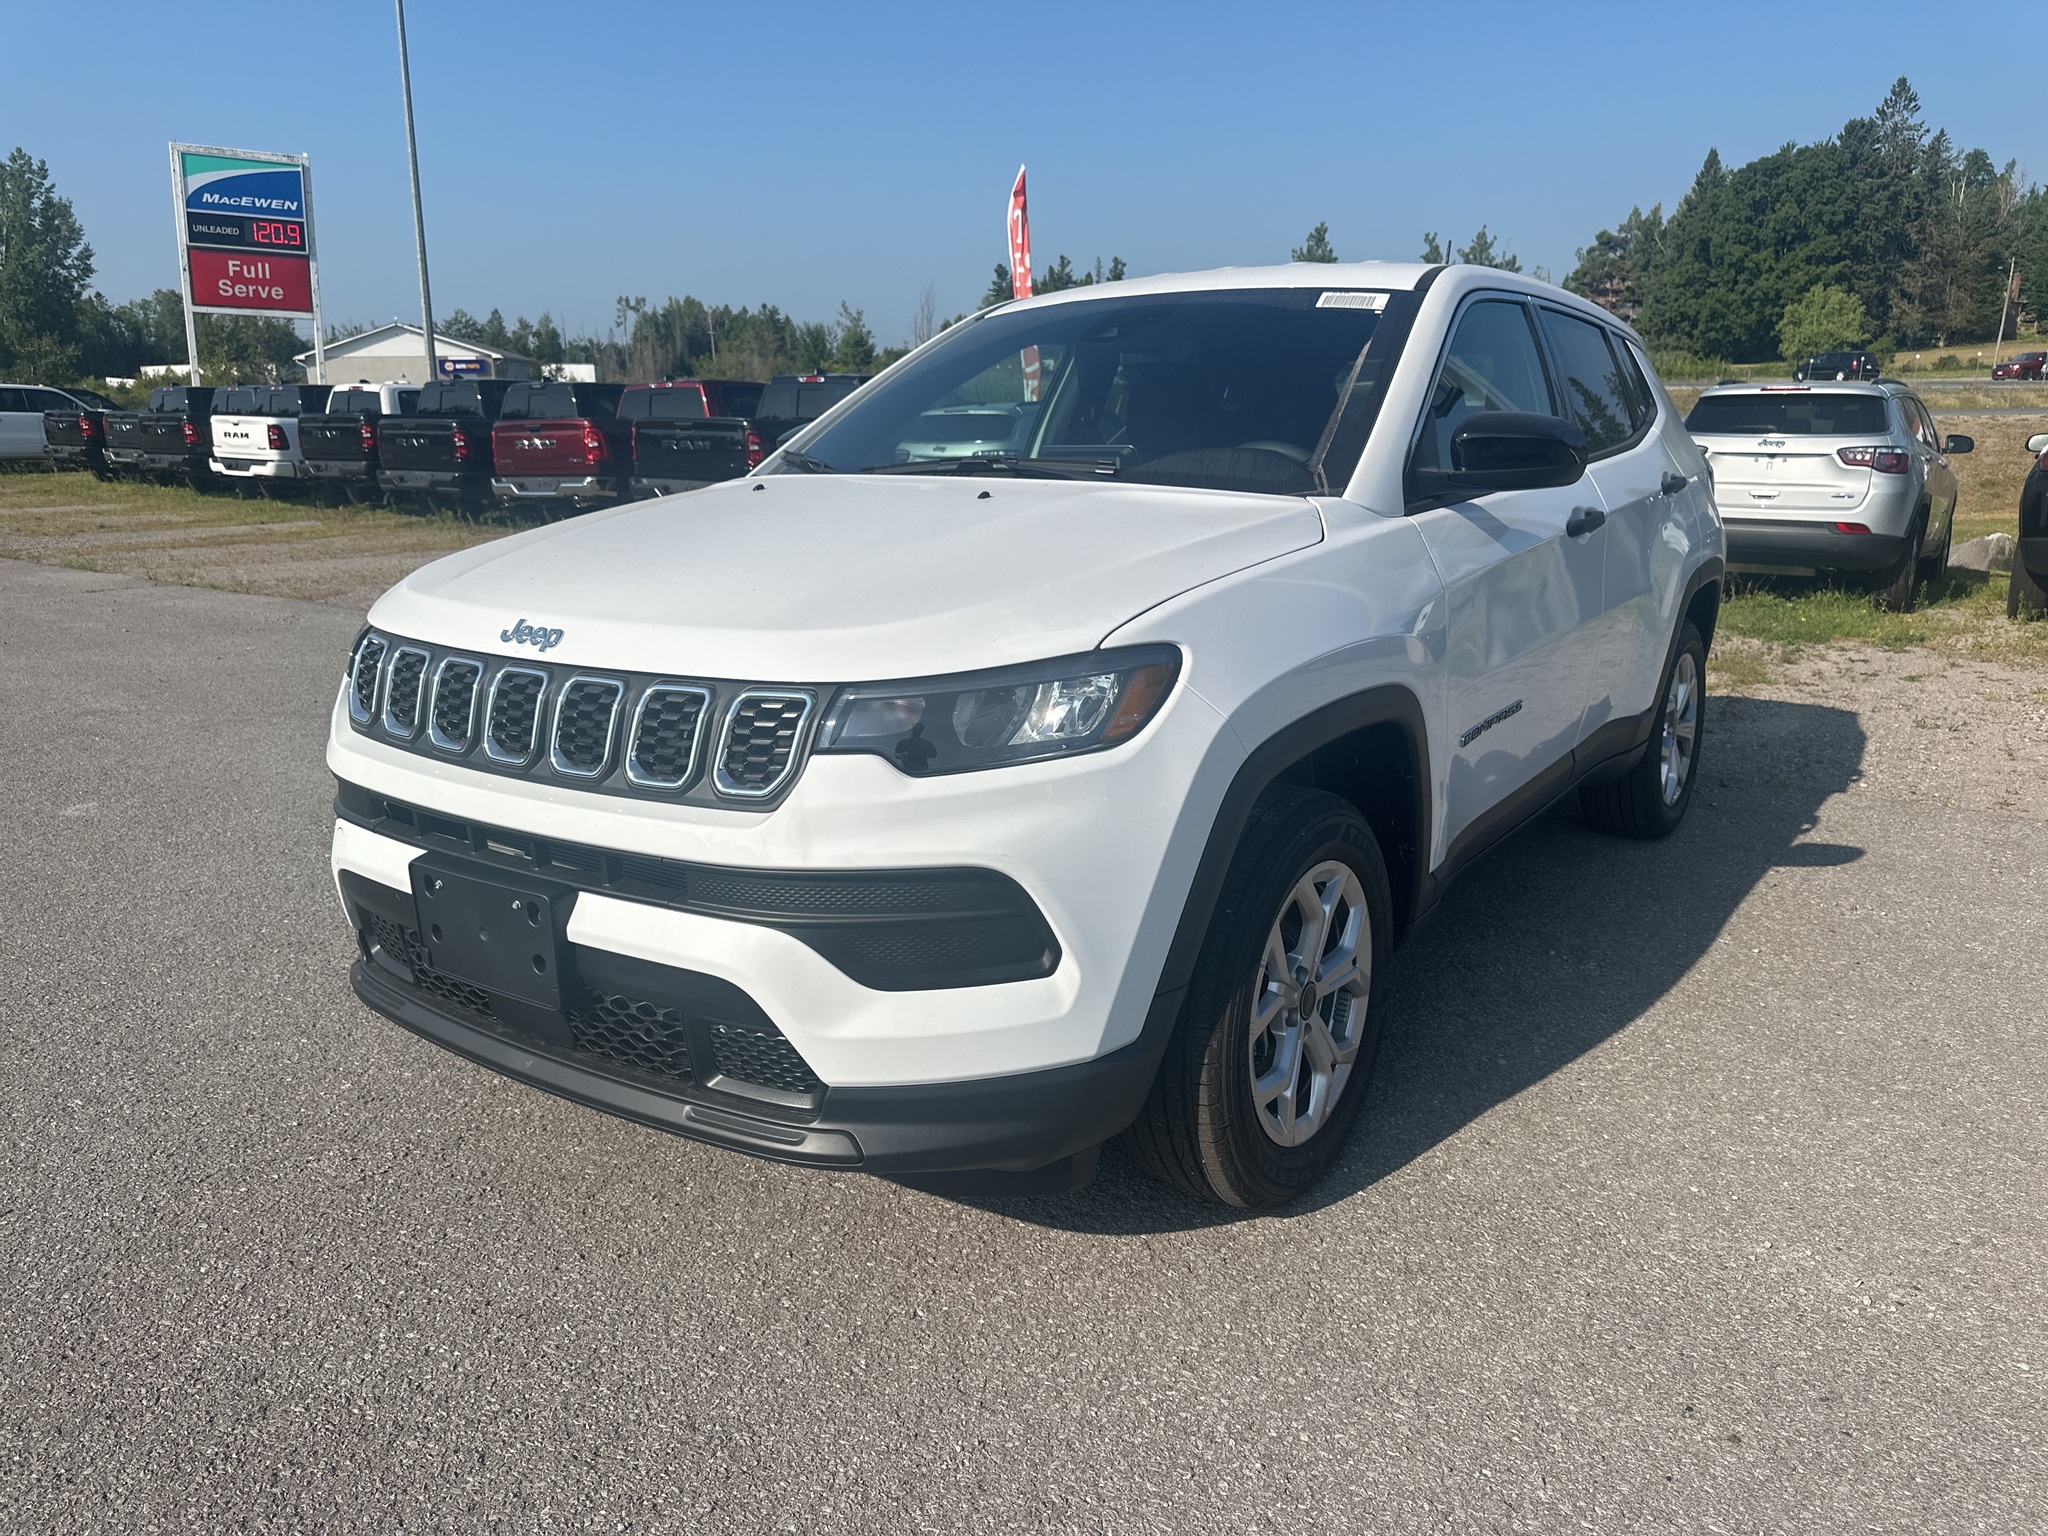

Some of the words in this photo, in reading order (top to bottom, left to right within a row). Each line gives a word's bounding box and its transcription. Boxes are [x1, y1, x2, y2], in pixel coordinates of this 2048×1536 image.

[192, 224, 240, 236] UNLEADED
[252, 222, 300, 245] 120.9
[228, 260, 270, 279] Full
[218, 279, 284, 299] Serve
[223, 431, 250, 439] RAM
[661, 440, 711, 450] RAM
[500, 618, 564, 652] Jeep
[1459, 699, 1523, 748] COMPASS
